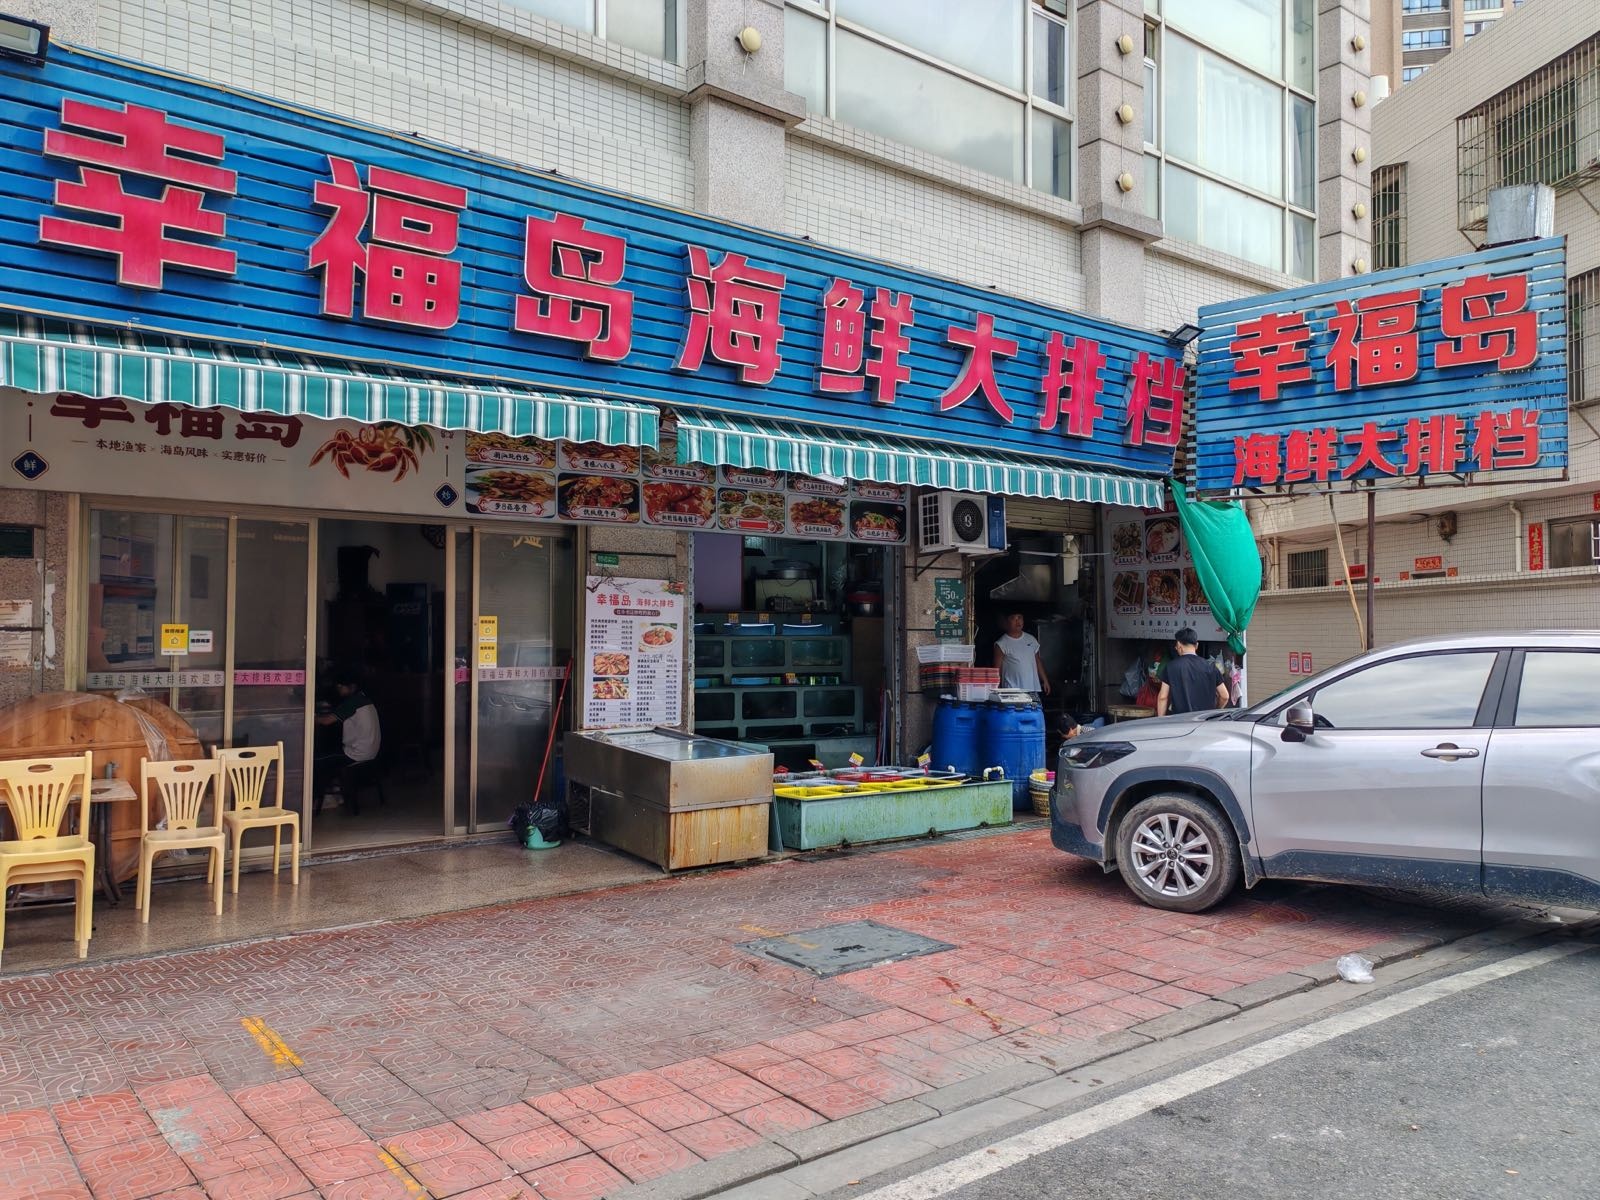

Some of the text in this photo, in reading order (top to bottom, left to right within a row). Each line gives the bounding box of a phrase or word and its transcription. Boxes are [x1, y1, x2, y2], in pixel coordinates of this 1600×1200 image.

[38, 97, 1187, 447] 幸福岛海鲜大排档
[1228, 272, 1540, 401] 幸福岛
[95, 438, 268, 464] 本地渔家 海岛风味 实惠好价
[1232, 407, 1542, 486] 海鲜大排档
[596, 593, 632, 606] 幸福岛
